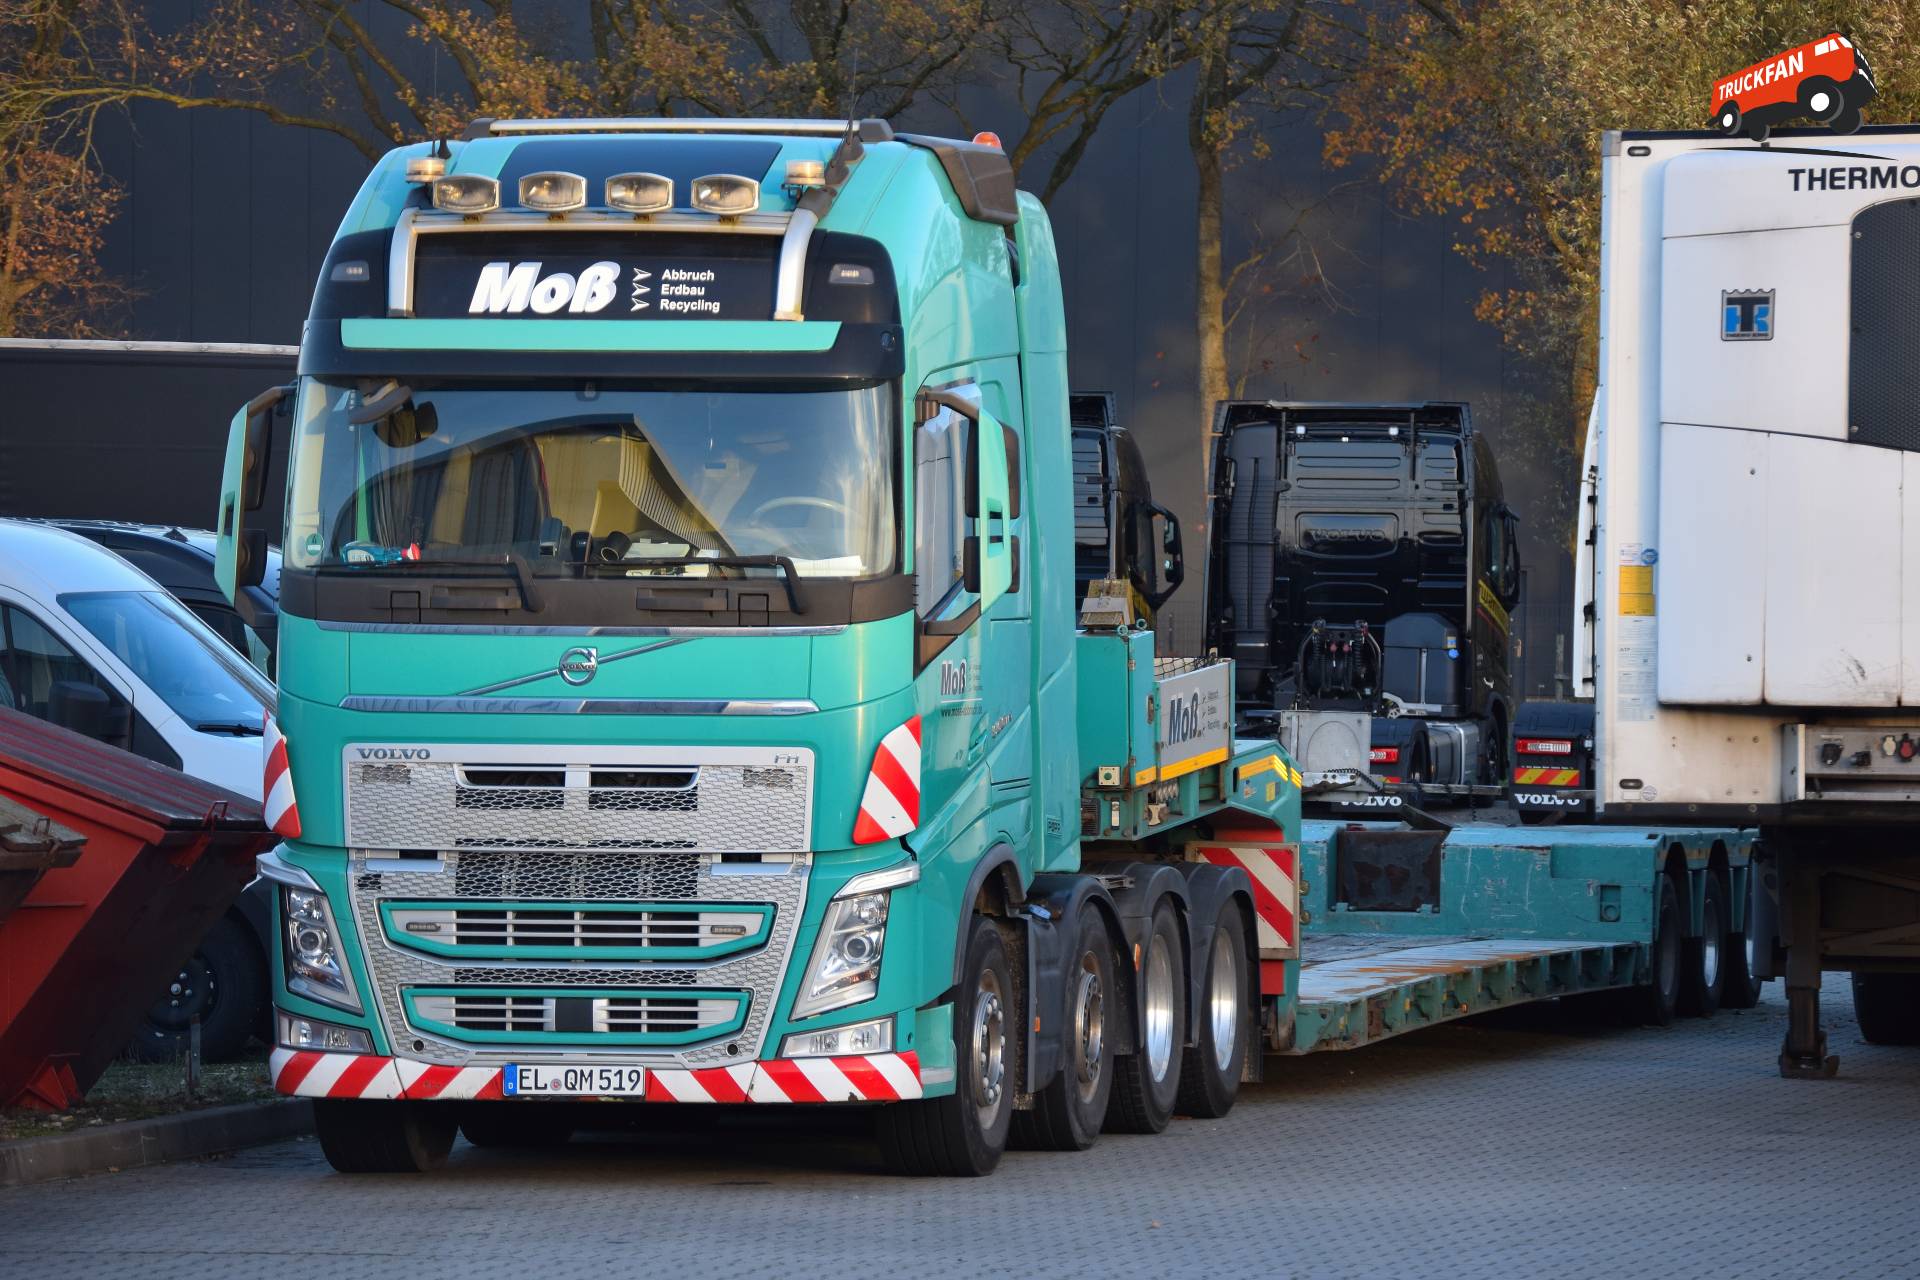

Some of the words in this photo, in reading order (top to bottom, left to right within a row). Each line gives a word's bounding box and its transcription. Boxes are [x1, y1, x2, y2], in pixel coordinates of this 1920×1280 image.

[1788, 165, 1920, 192] THERMO
[661, 269, 715, 281] Abbruch
[468, 260, 621, 315] Moß
[660, 283, 705, 296] Erdbau
[659, 298, 721, 314] Recycling
[940, 658, 967, 696] Moß
[1168, 689, 1200, 746] Moß
[356, 747, 431, 760] VOLVO
[519, 1068, 548, 1091] EL
[564, 1069, 594, 1091] QM
[599, 1069, 641, 1091] 519
